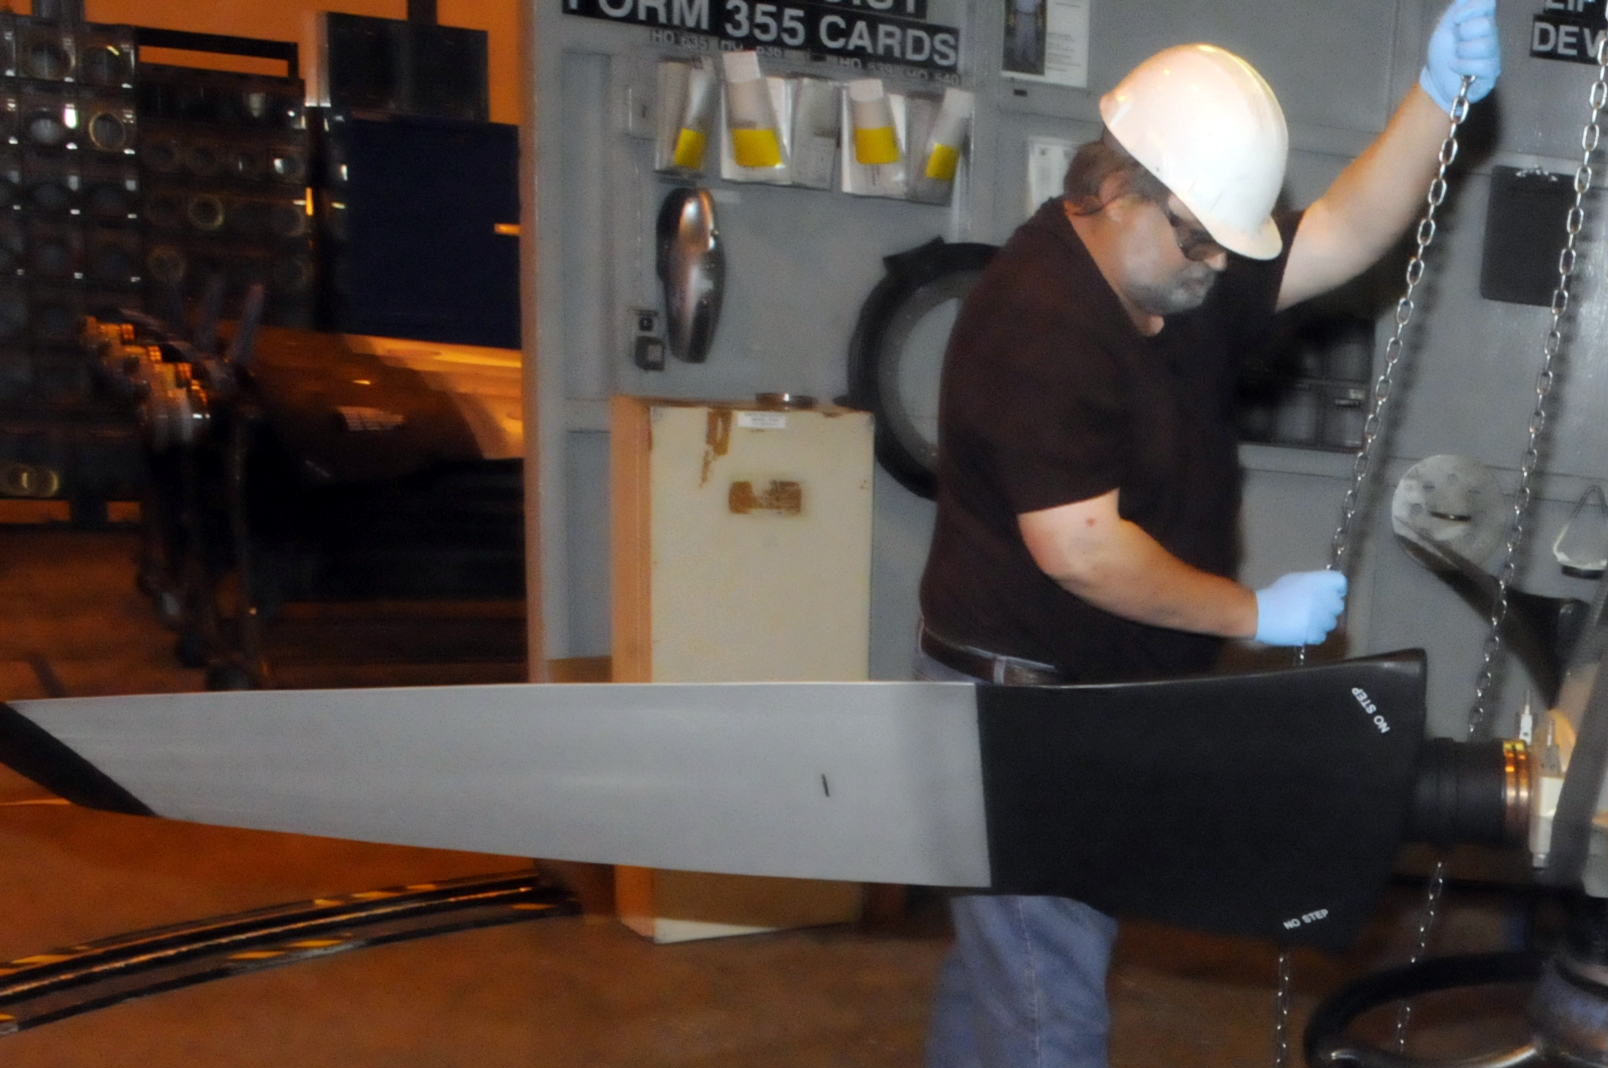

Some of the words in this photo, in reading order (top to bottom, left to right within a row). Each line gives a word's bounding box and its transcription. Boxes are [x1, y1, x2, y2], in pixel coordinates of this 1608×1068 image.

[724, 0, 805, 47] 355
[818, 15, 959, 67] CARDS
[1351, 687, 1377, 714] STEP
[1373, 714, 1390, 733] NO
[1283, 918, 1301, 930] NO
[1301, 908, 1328, 924] STEP
